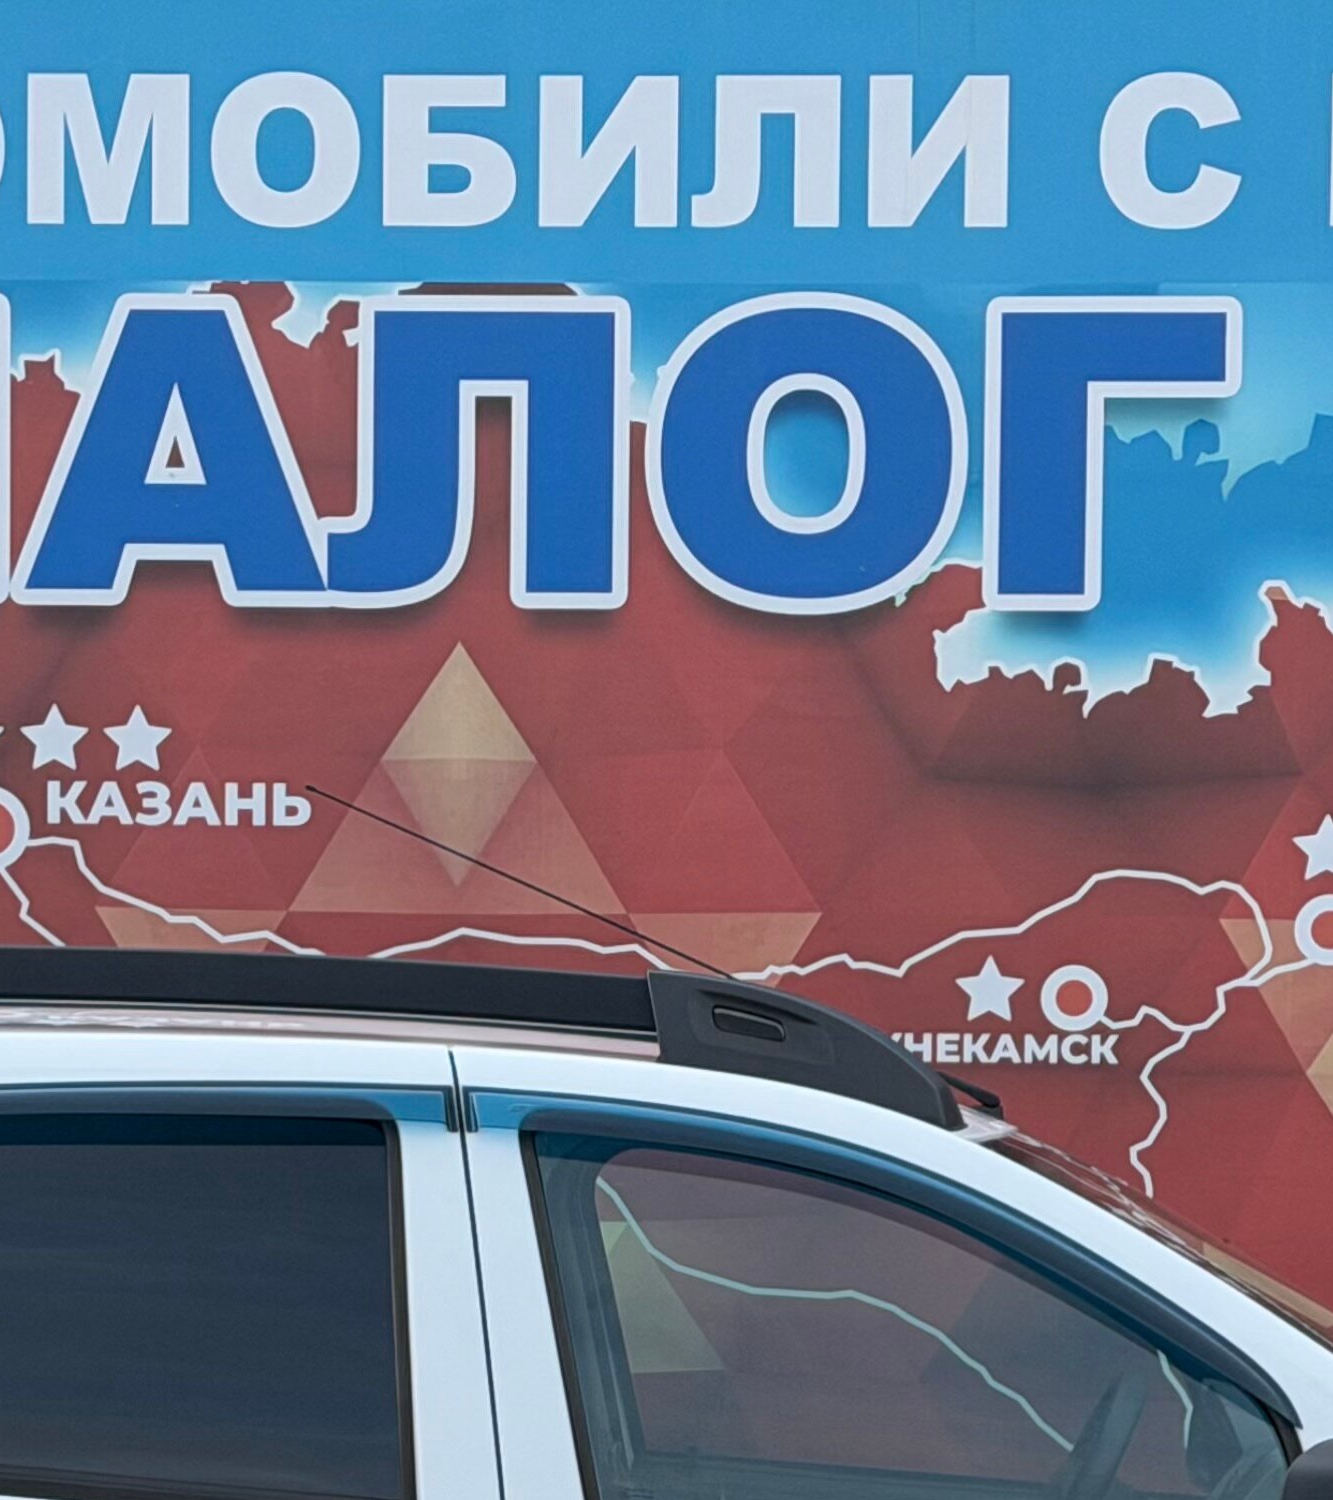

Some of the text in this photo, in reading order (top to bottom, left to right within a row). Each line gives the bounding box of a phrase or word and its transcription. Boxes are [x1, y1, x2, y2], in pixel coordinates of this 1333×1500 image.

[1099, 71, 1243, 230] С
[45, 779, 312, 827] КАЗАНЬ
[891, 1032, 1120, 1065] НЕКАМСК
